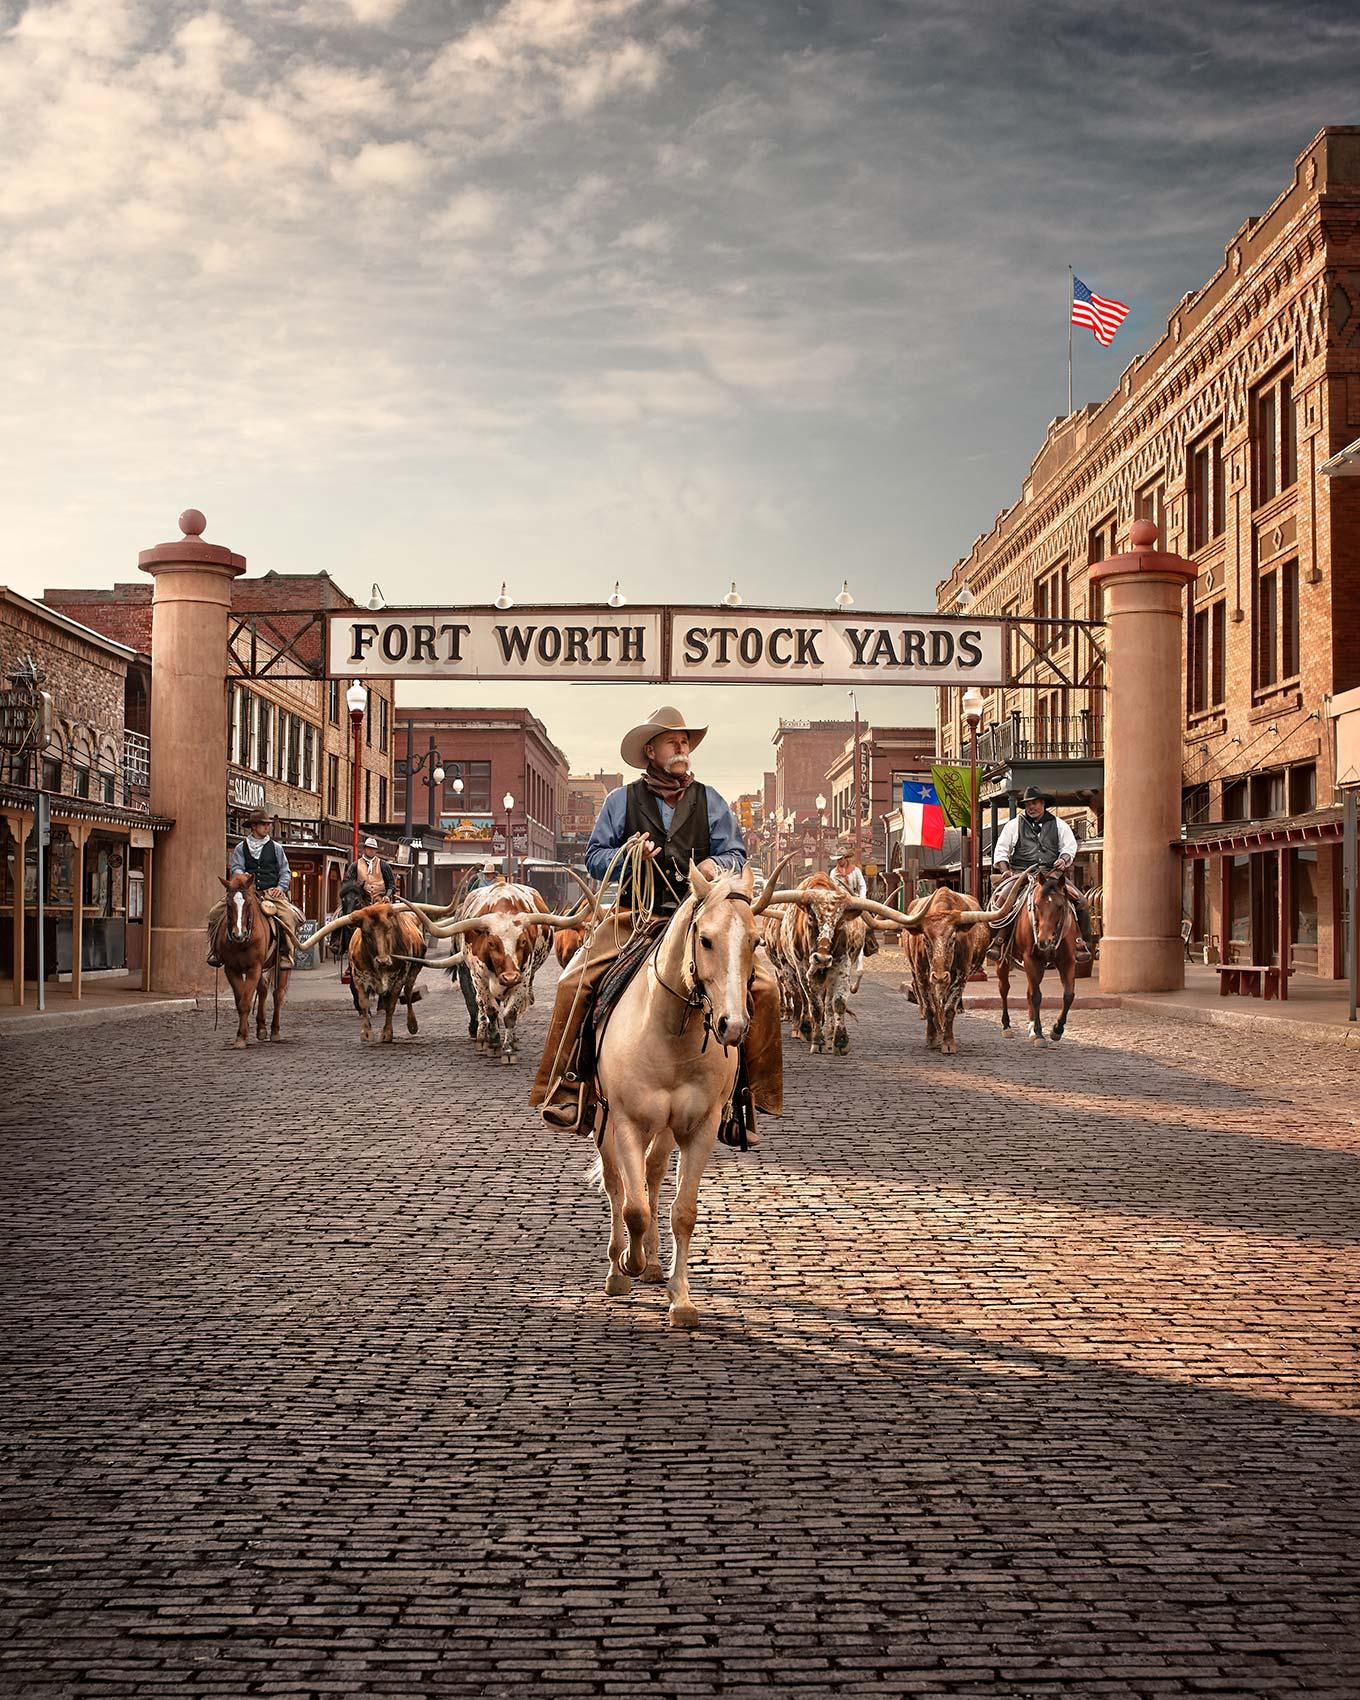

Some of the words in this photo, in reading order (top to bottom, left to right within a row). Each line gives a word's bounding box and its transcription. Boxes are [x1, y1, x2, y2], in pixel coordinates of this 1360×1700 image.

[349, 623, 471, 663] FORT
[494, 624, 647, 665] WORTH
[683, 626, 825, 667] STOCK
[844, 627, 983, 670] YARDS
[235, 777, 258, 807] SALOON
